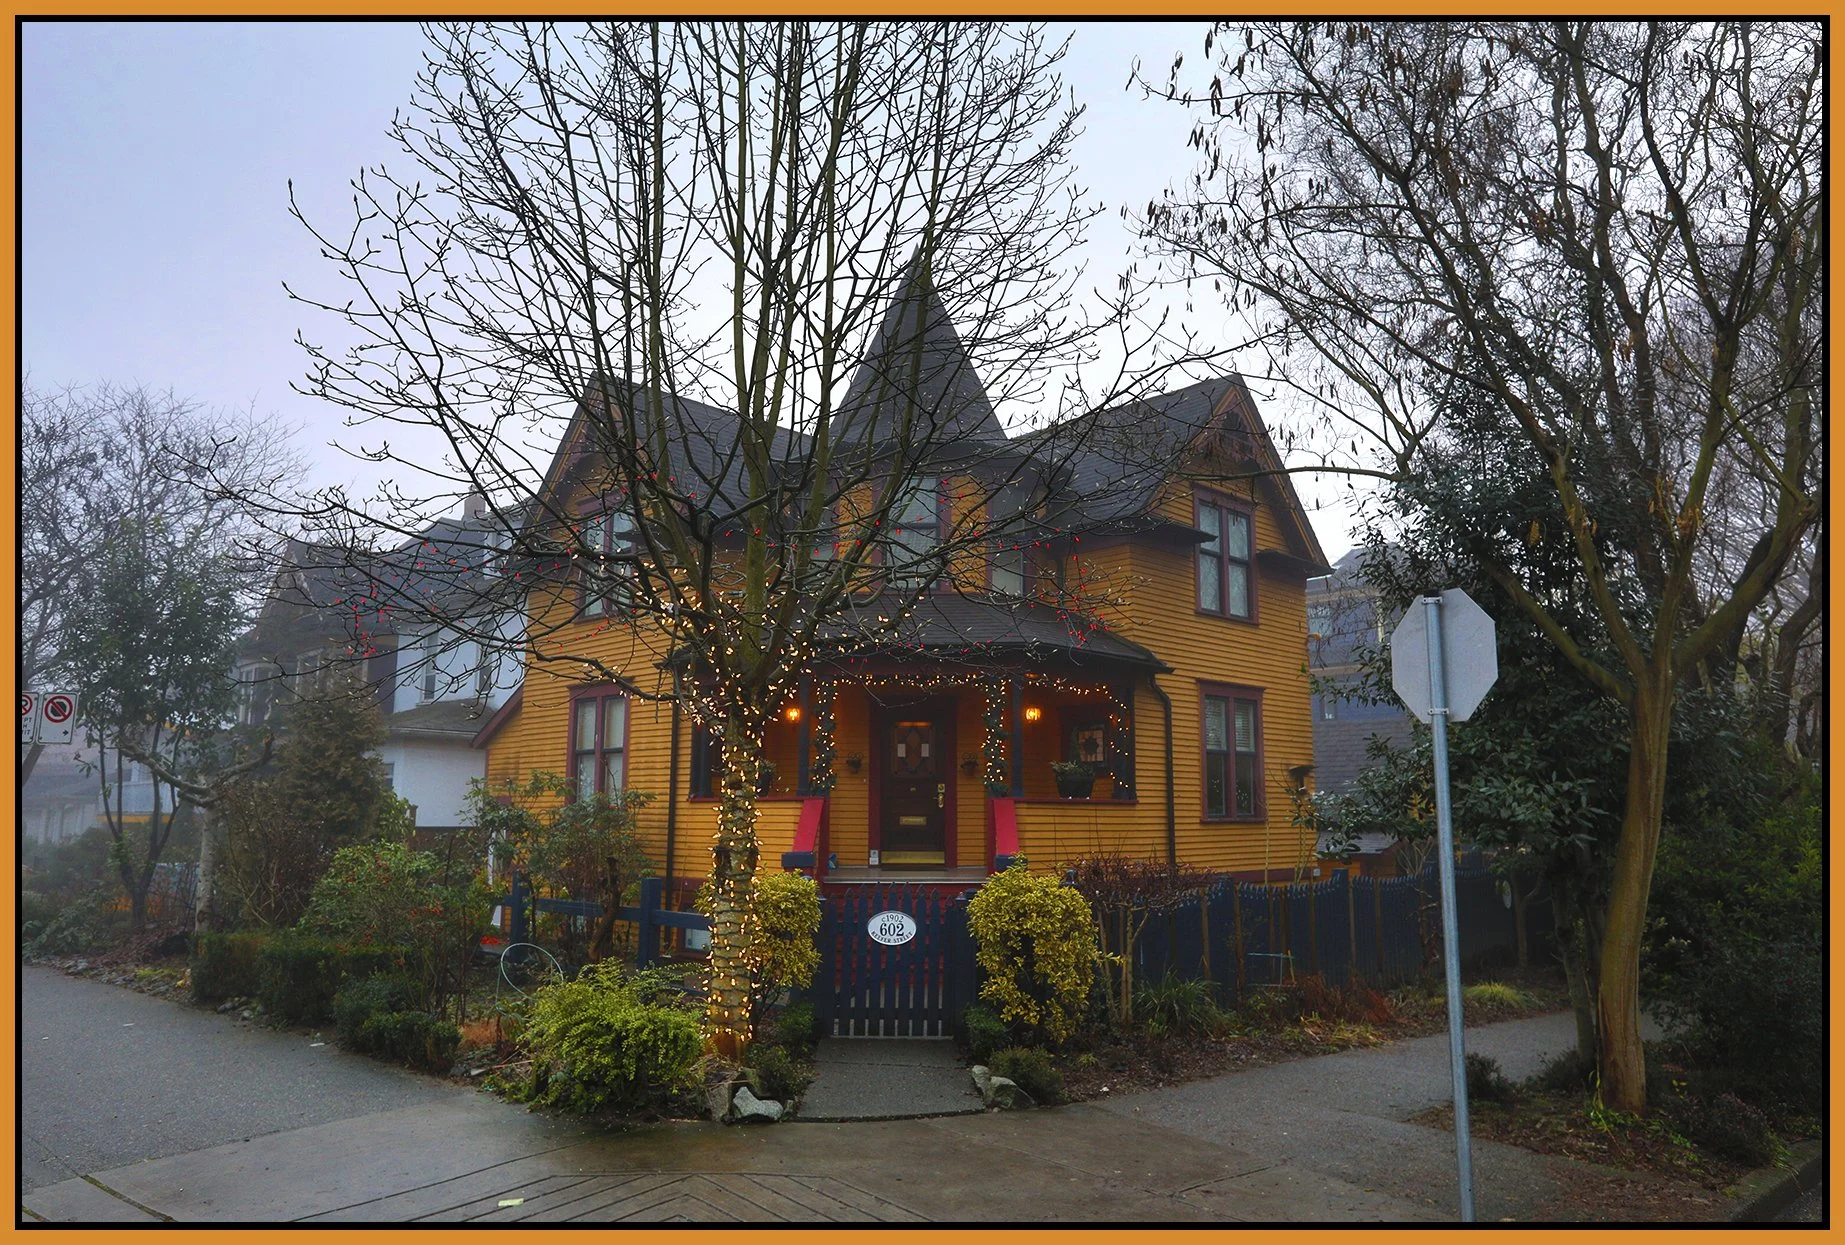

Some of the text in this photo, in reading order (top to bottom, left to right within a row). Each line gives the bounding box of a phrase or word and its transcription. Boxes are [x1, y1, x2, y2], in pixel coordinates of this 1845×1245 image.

[881, 914, 904, 922] c1902
[880, 923, 904, 936] 602
[871, 931, 912, 943] KEEFER STREET
